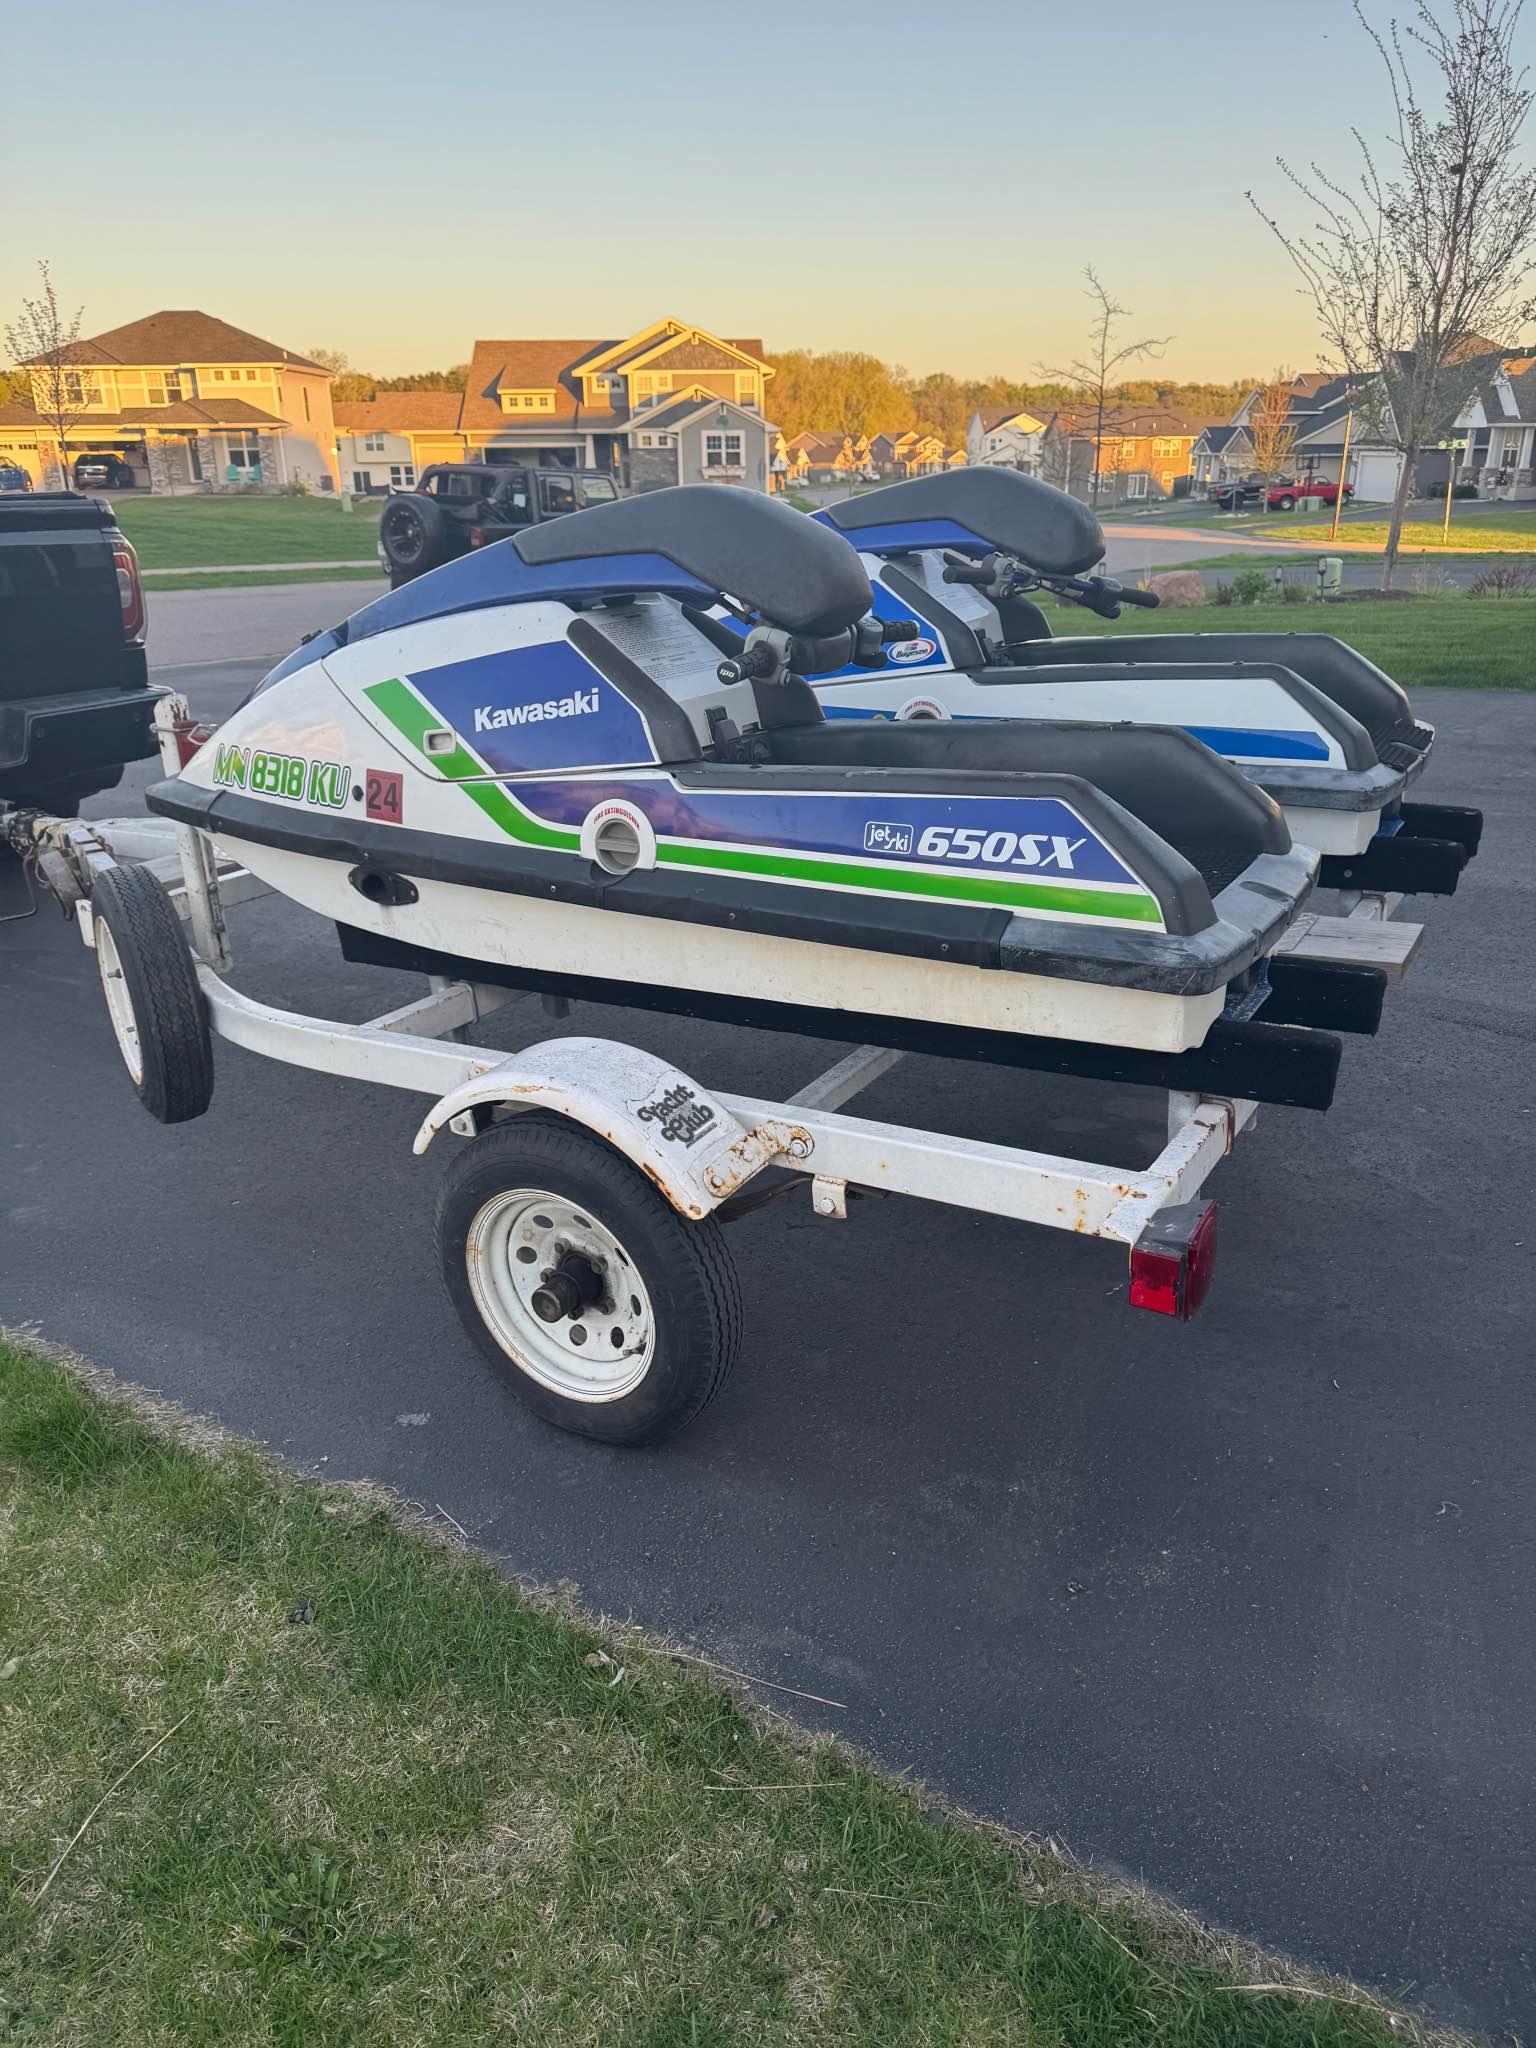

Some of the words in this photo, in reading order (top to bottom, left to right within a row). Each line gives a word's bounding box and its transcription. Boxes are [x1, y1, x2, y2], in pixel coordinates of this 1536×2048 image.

[474, 687, 600, 732] Kawasaki
[213, 743, 250, 789] MN
[250, 750, 307, 800] 8318
[308, 760, 351, 809] KU
[367, 778, 398, 813] 24
[868, 824, 891, 846] jet
[884, 832, 908, 851] ski
[917, 826, 1087, 869] 650SX
[637, 1083, 695, 1126] Yacht
[661, 1104, 715, 1142] Club
